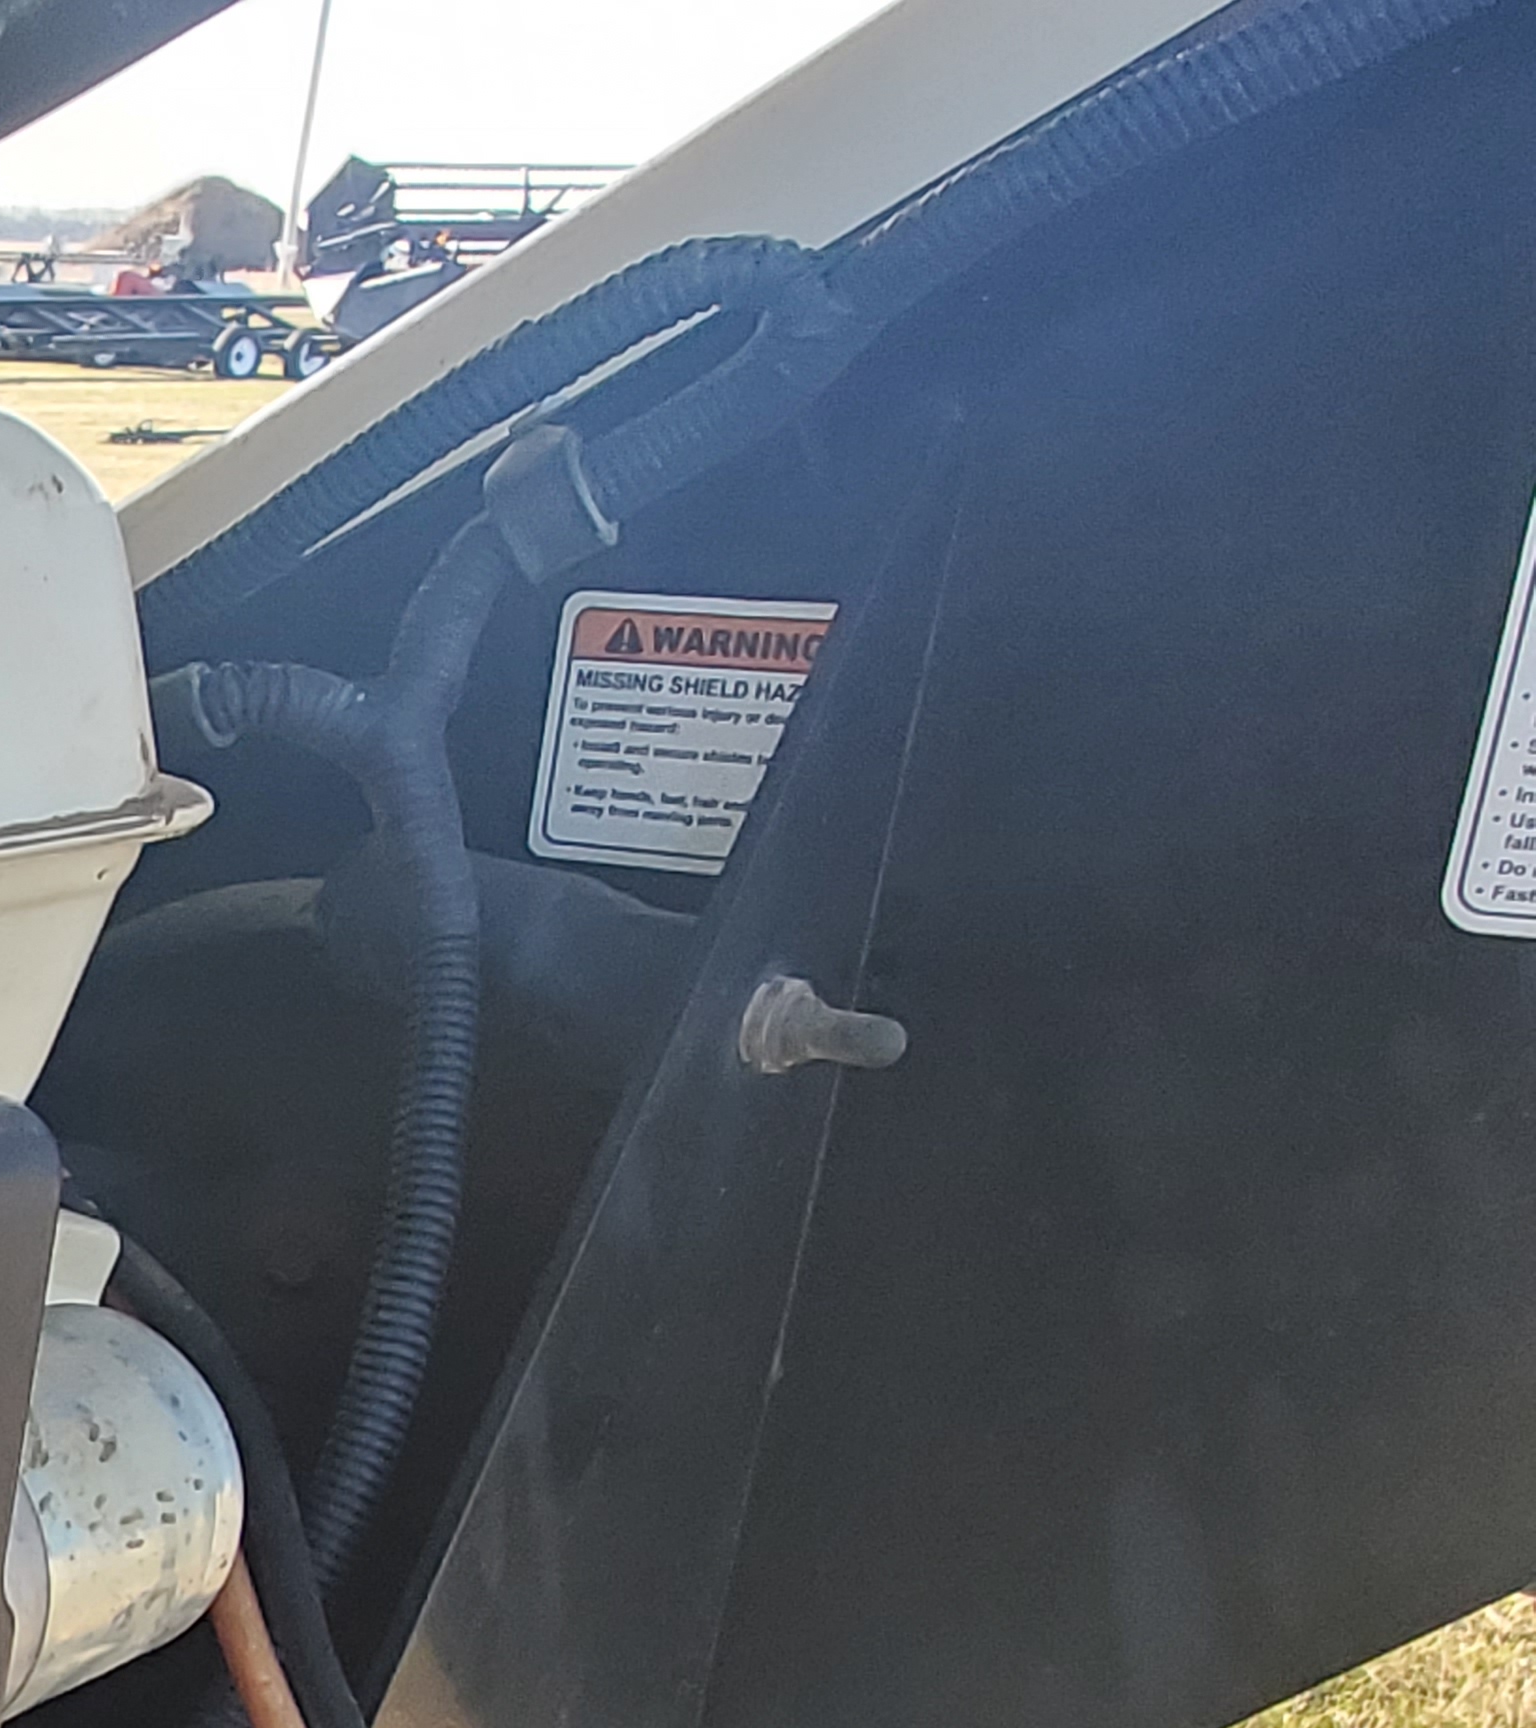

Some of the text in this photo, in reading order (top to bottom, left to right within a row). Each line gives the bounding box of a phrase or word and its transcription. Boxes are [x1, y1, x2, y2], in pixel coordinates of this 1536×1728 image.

[576, 668, 663, 693] MISSING
[668, 675, 749, 699] SHIELD
[1497, 859, 1526, 876] Do
